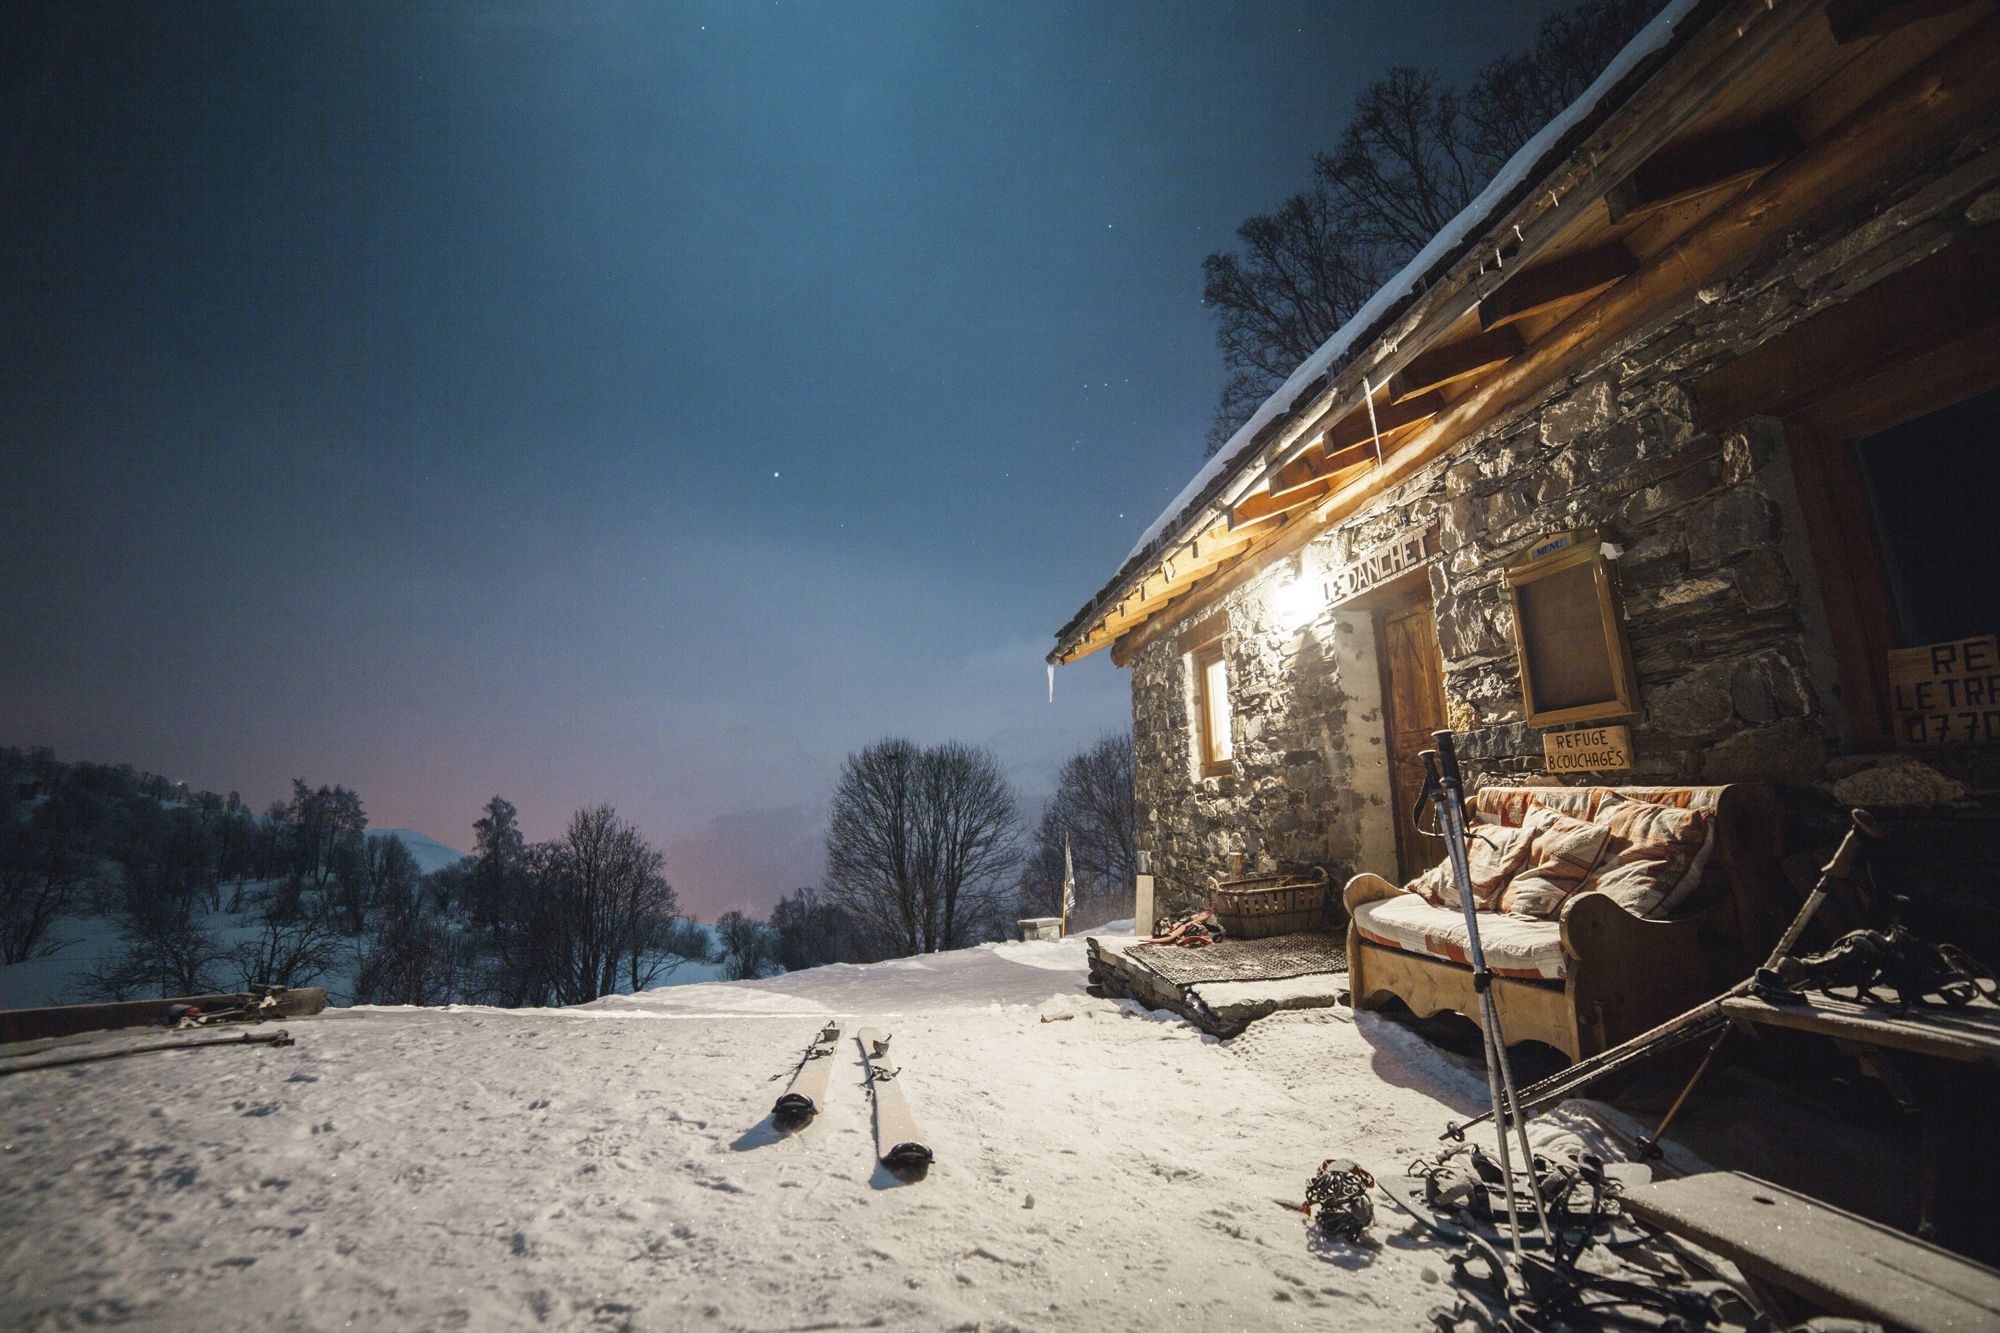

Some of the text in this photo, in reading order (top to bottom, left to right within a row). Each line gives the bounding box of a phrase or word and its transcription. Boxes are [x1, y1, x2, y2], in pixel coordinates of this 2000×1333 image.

[1536, 539, 1563, 556] MENU
[1343, 530, 1428, 593] DANCHET
[1556, 729, 1608, 749] REFUGE
